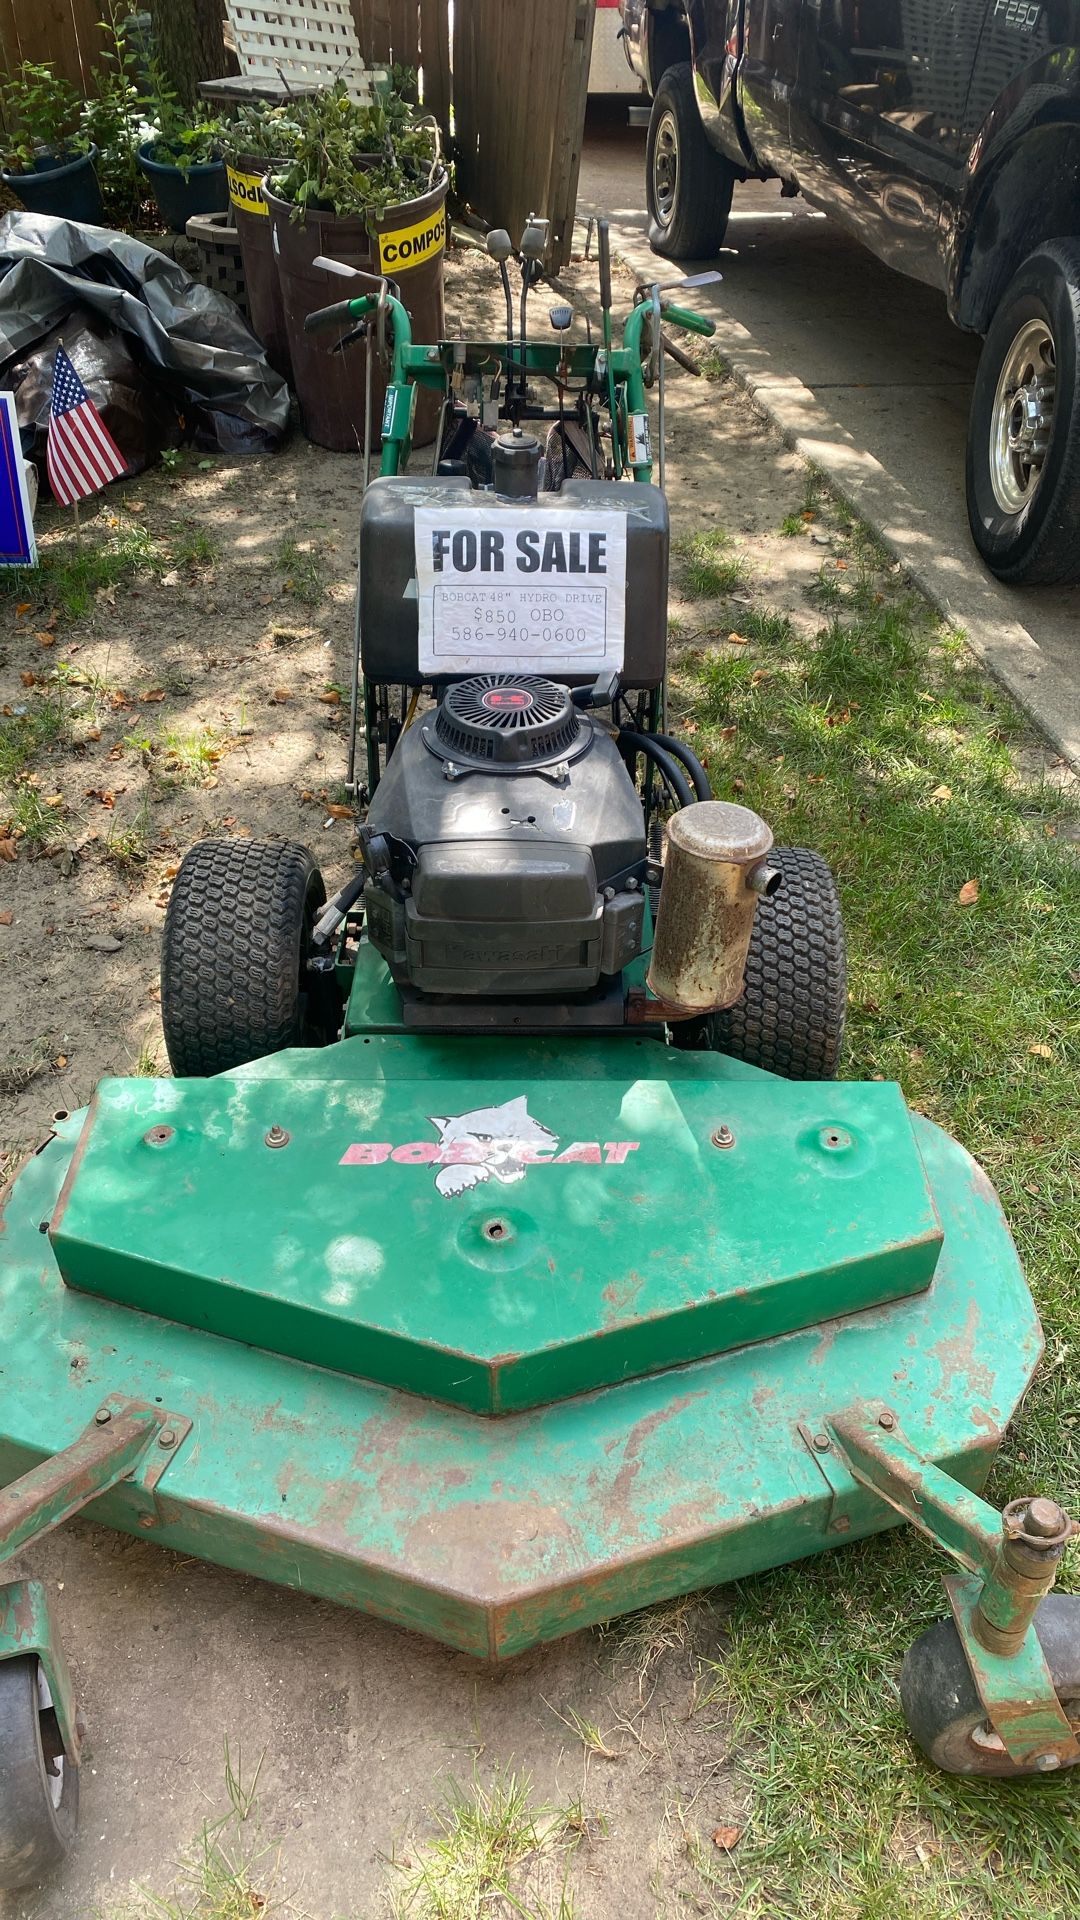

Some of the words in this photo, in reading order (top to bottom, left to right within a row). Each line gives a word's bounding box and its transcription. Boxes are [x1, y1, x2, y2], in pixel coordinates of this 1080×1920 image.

[994, 0, 1040, 26] F250
[384, 394, 395, 428] IMPORTANT
[432, 529, 505, 573] FOR
[516, 529, 607, 574] SALE
[441, 592, 487, 602] BOBCAT
[519, 593, 557, 603] HYDRO
[565, 593, 603, 604] DRIVE
[474, 607, 516, 624] $850
[530, 608, 564, 622] OBO
[452, 626, 586, 641] 586-940-0600
